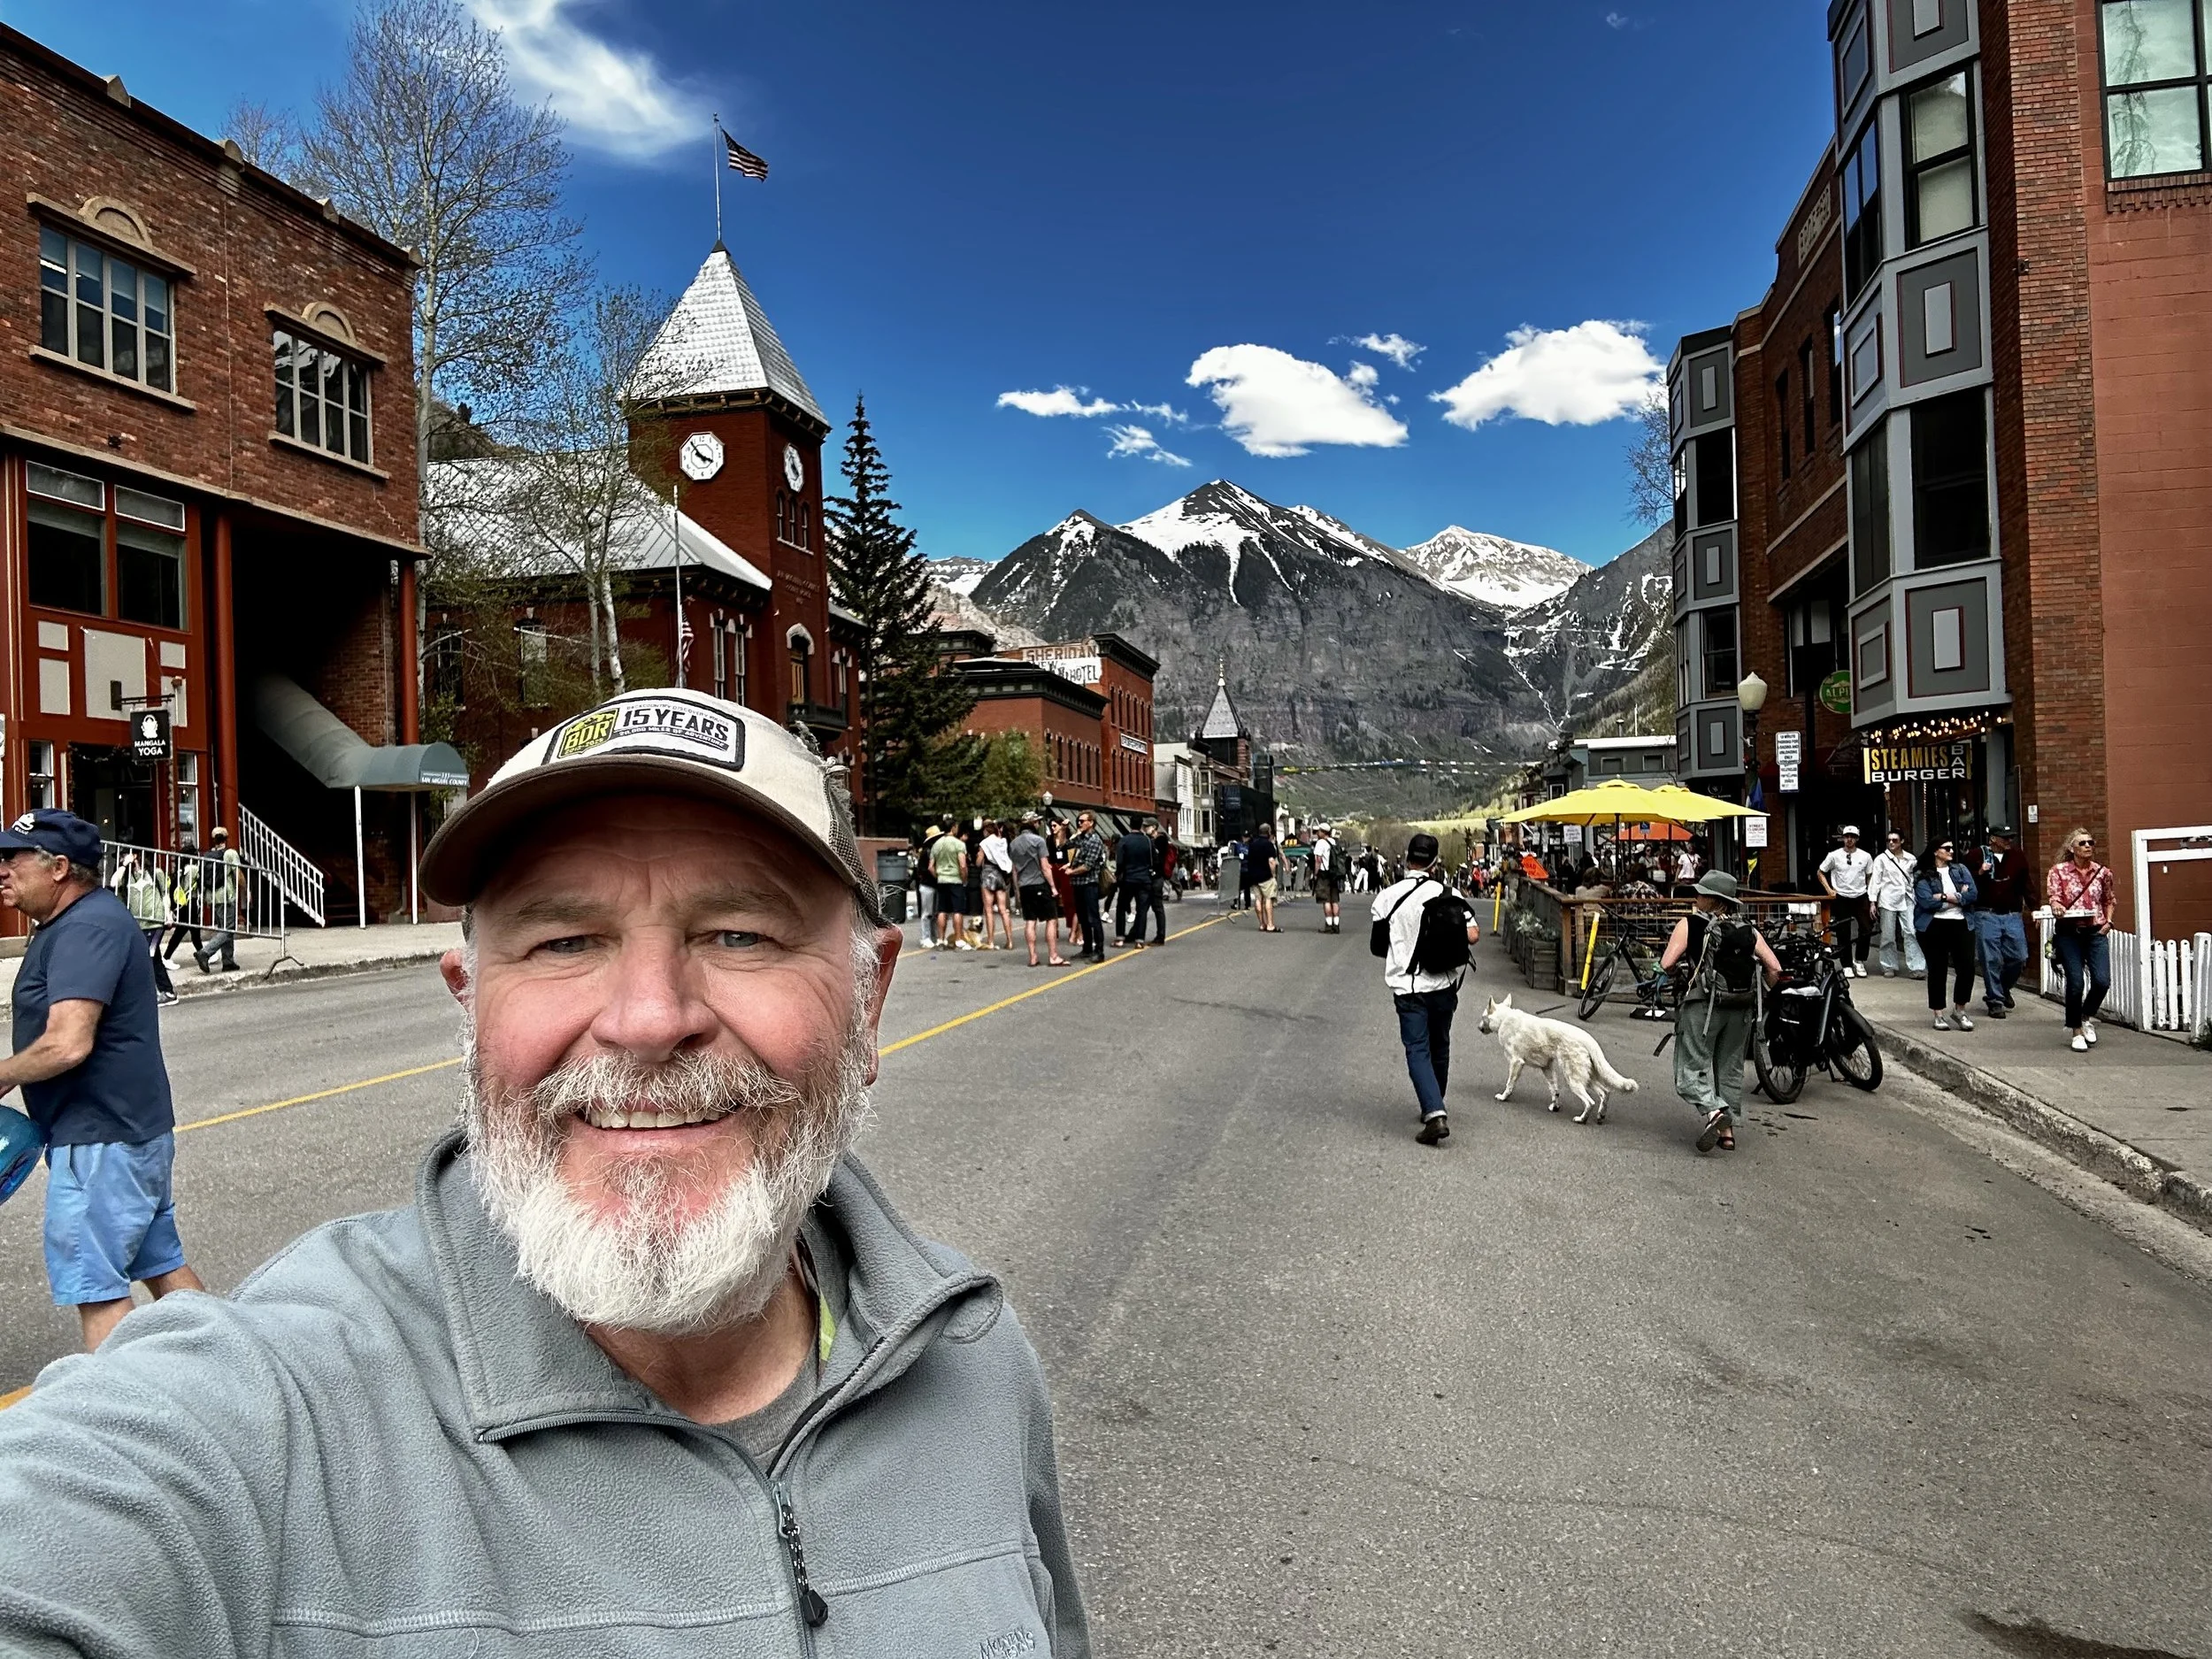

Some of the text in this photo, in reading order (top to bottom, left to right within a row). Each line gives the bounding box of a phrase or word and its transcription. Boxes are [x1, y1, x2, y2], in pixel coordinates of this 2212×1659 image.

[1026, 645, 1096, 662] SHERIDAN
[1070, 664, 1098, 681] HOTEL
[1825, 687, 1850, 697] ALPI
[623, 708, 728, 741] 15 YEARS
[565, 720, 610, 750] BDR
[684, 731, 726, 748] ADVENTURE
[138, 747, 163, 756] YOGA
[1871, 745, 1948, 771] STEAMIES
[1871, 767, 1965, 782] BURGER
